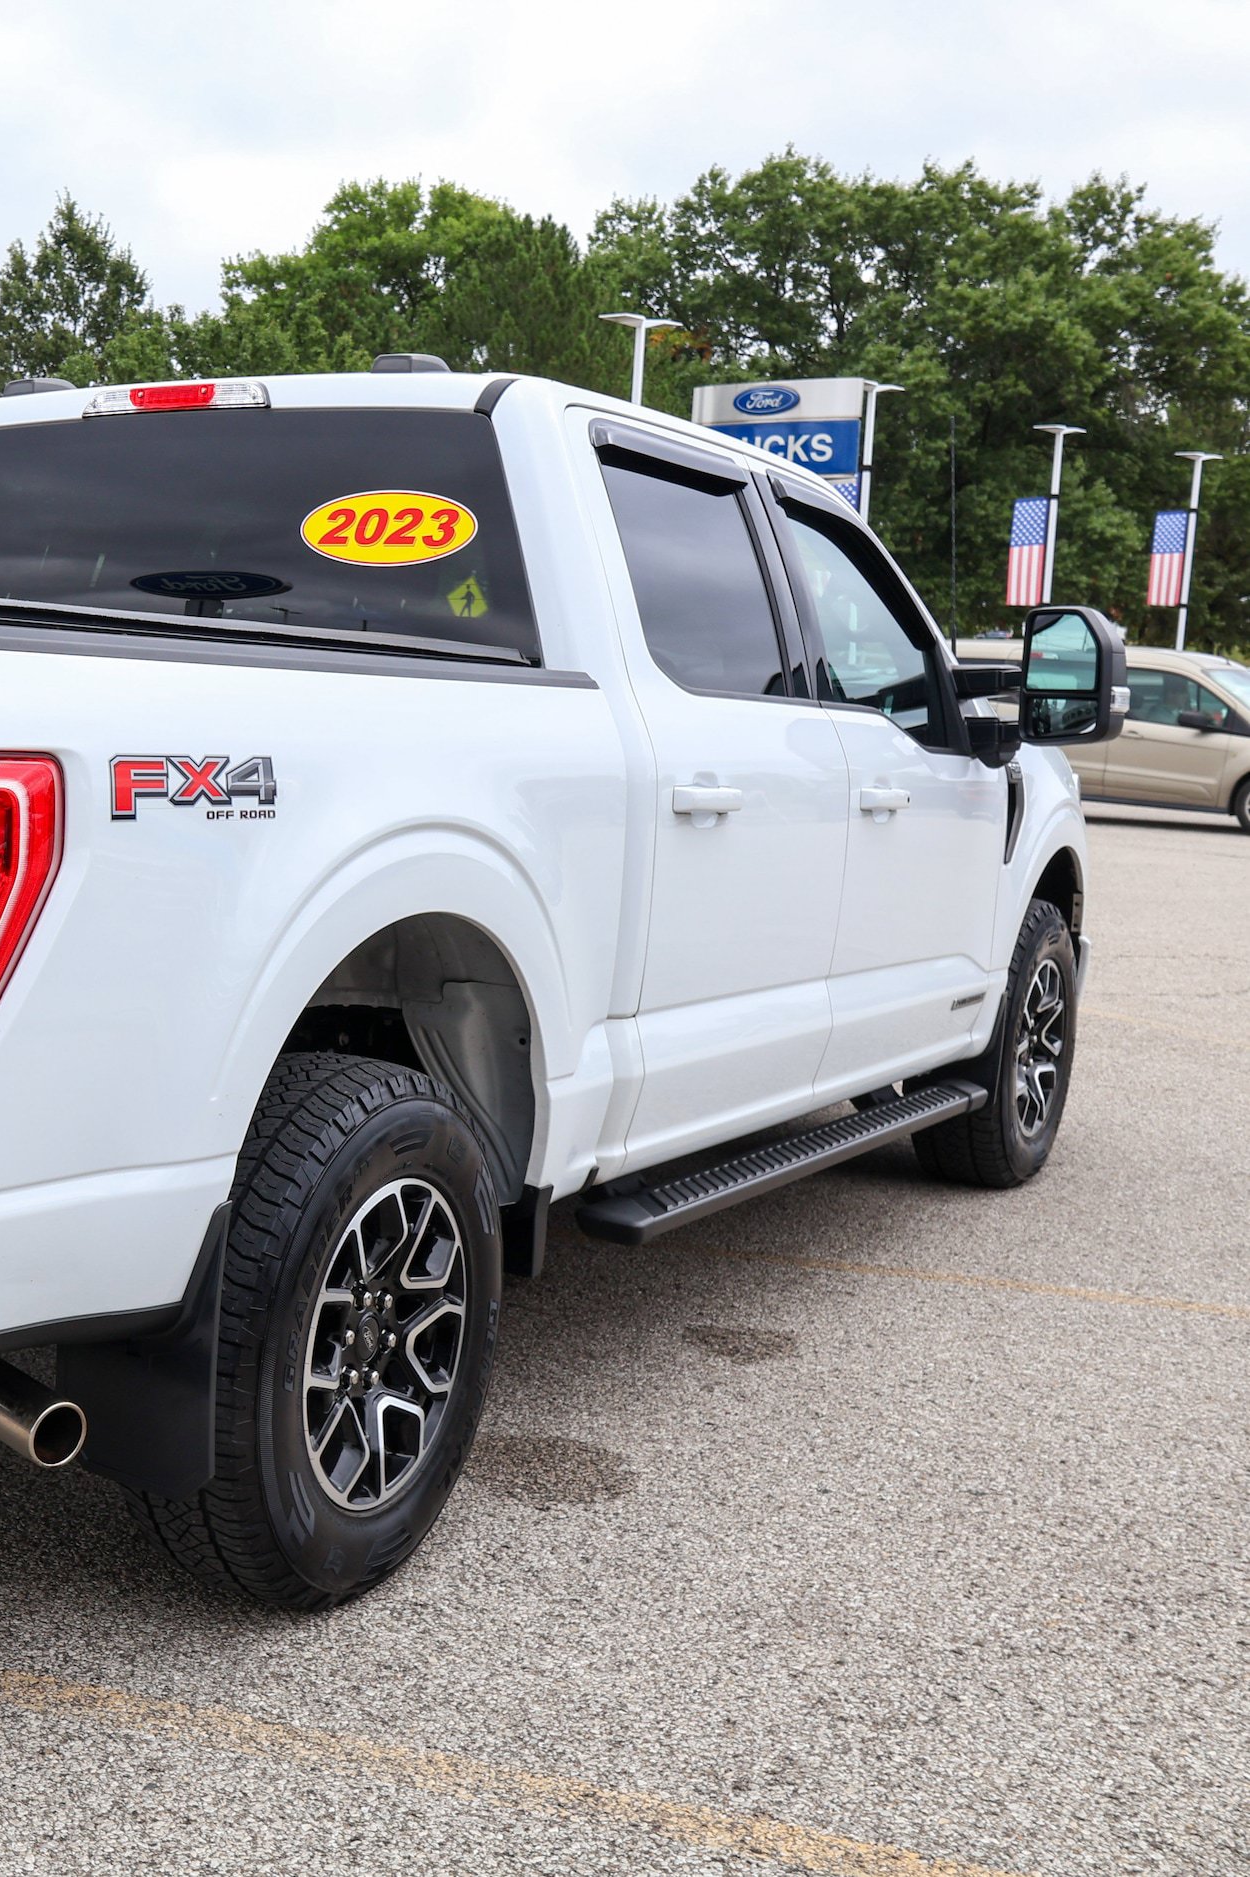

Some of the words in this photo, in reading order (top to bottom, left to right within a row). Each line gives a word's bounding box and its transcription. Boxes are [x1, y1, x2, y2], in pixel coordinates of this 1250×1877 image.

[746, 391, 783, 409] Ford
[742, 433, 833, 463] CKS
[317, 508, 460, 549] 2023
[109, 754, 277, 821] FX4
[206, 810, 235, 820] OFF
[240, 809, 276, 820] ROAD
